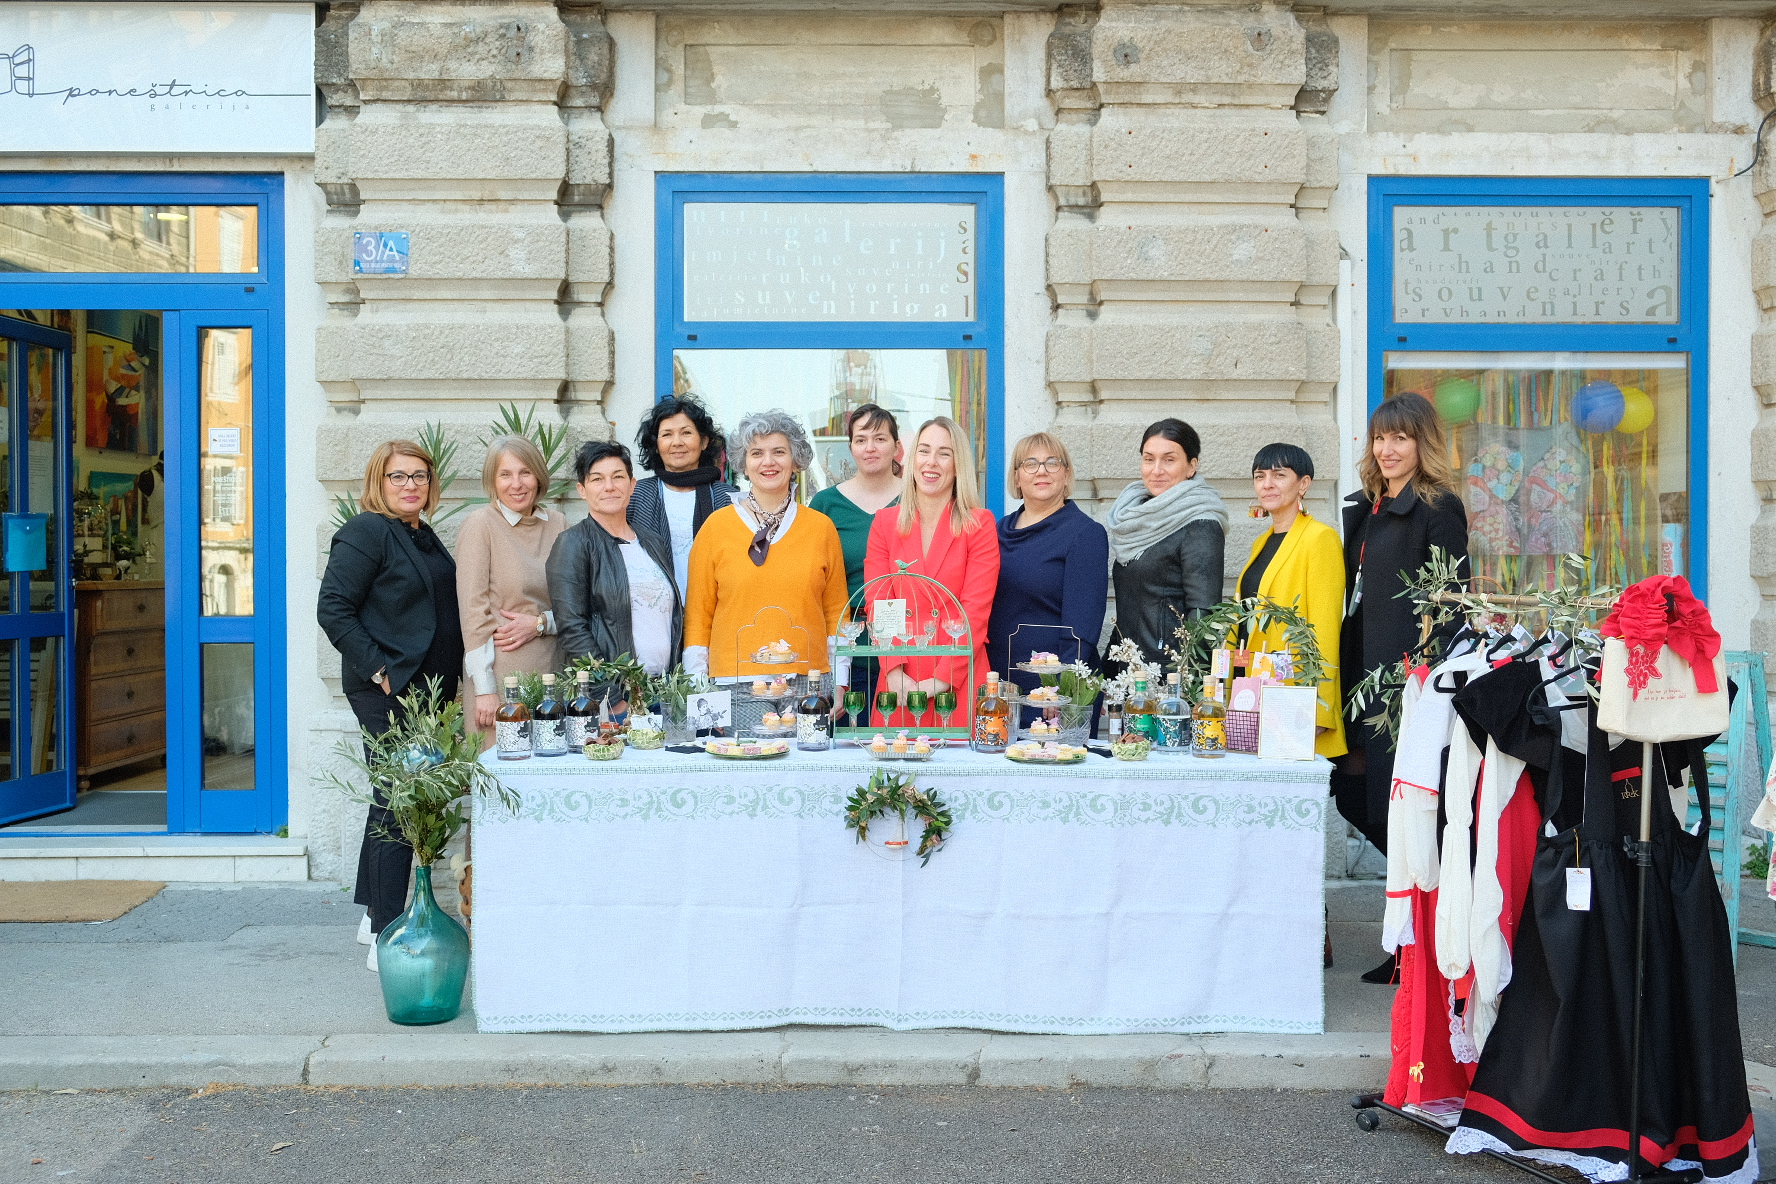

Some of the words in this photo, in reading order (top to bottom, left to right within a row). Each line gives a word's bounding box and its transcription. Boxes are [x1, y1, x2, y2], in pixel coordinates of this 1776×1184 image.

[63, 79, 250, 106] poneštrica
[150, 102, 250, 112] galerija
[362, 237, 400, 261] 3/A
